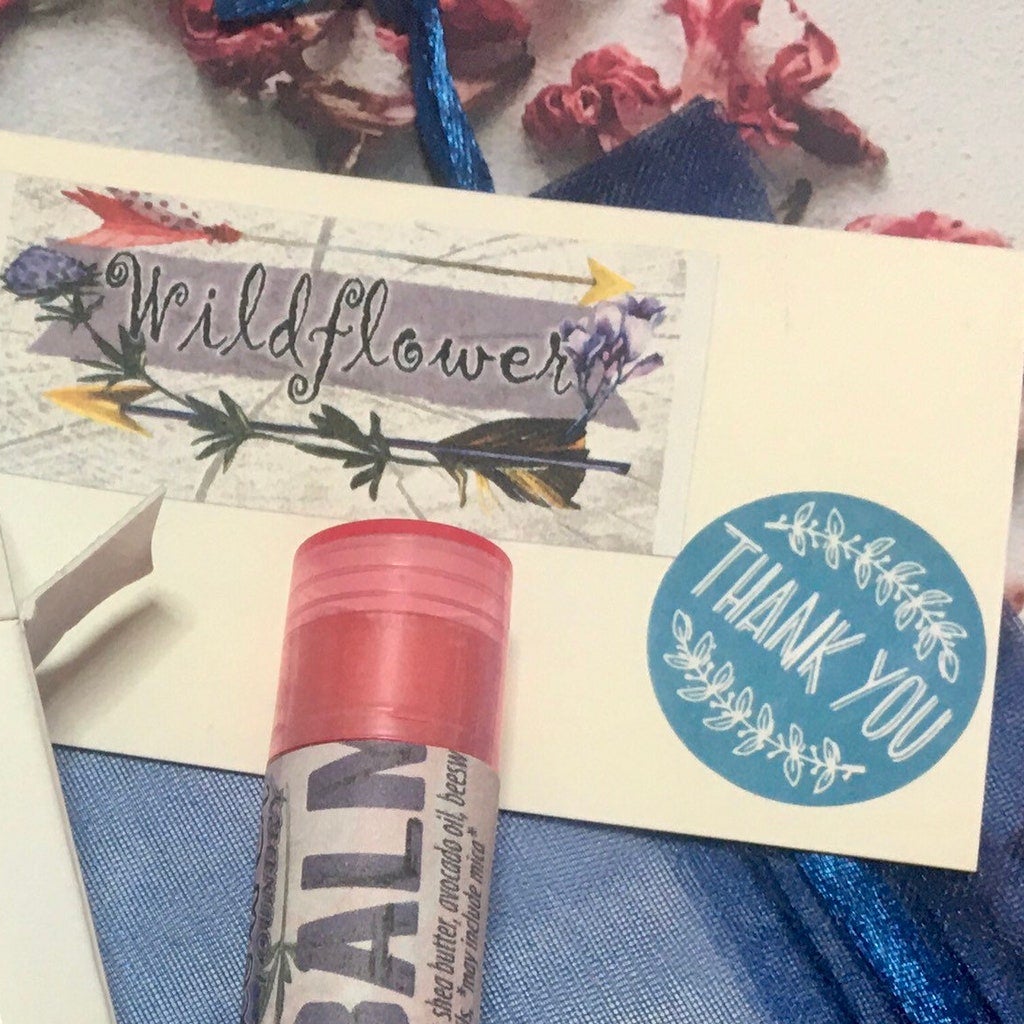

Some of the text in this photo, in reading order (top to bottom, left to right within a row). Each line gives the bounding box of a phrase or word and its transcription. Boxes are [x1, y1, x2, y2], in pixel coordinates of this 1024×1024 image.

[106, 251, 576, 404] Wildflower
[691, 522, 954, 763] THANK YOU
[436, 809, 468, 837] oil,
[434, 838, 462, 913] avocado
[427, 916, 461, 975] butter,
[461, 884, 481, 951] include
[425, 975, 454, 1021] shea
